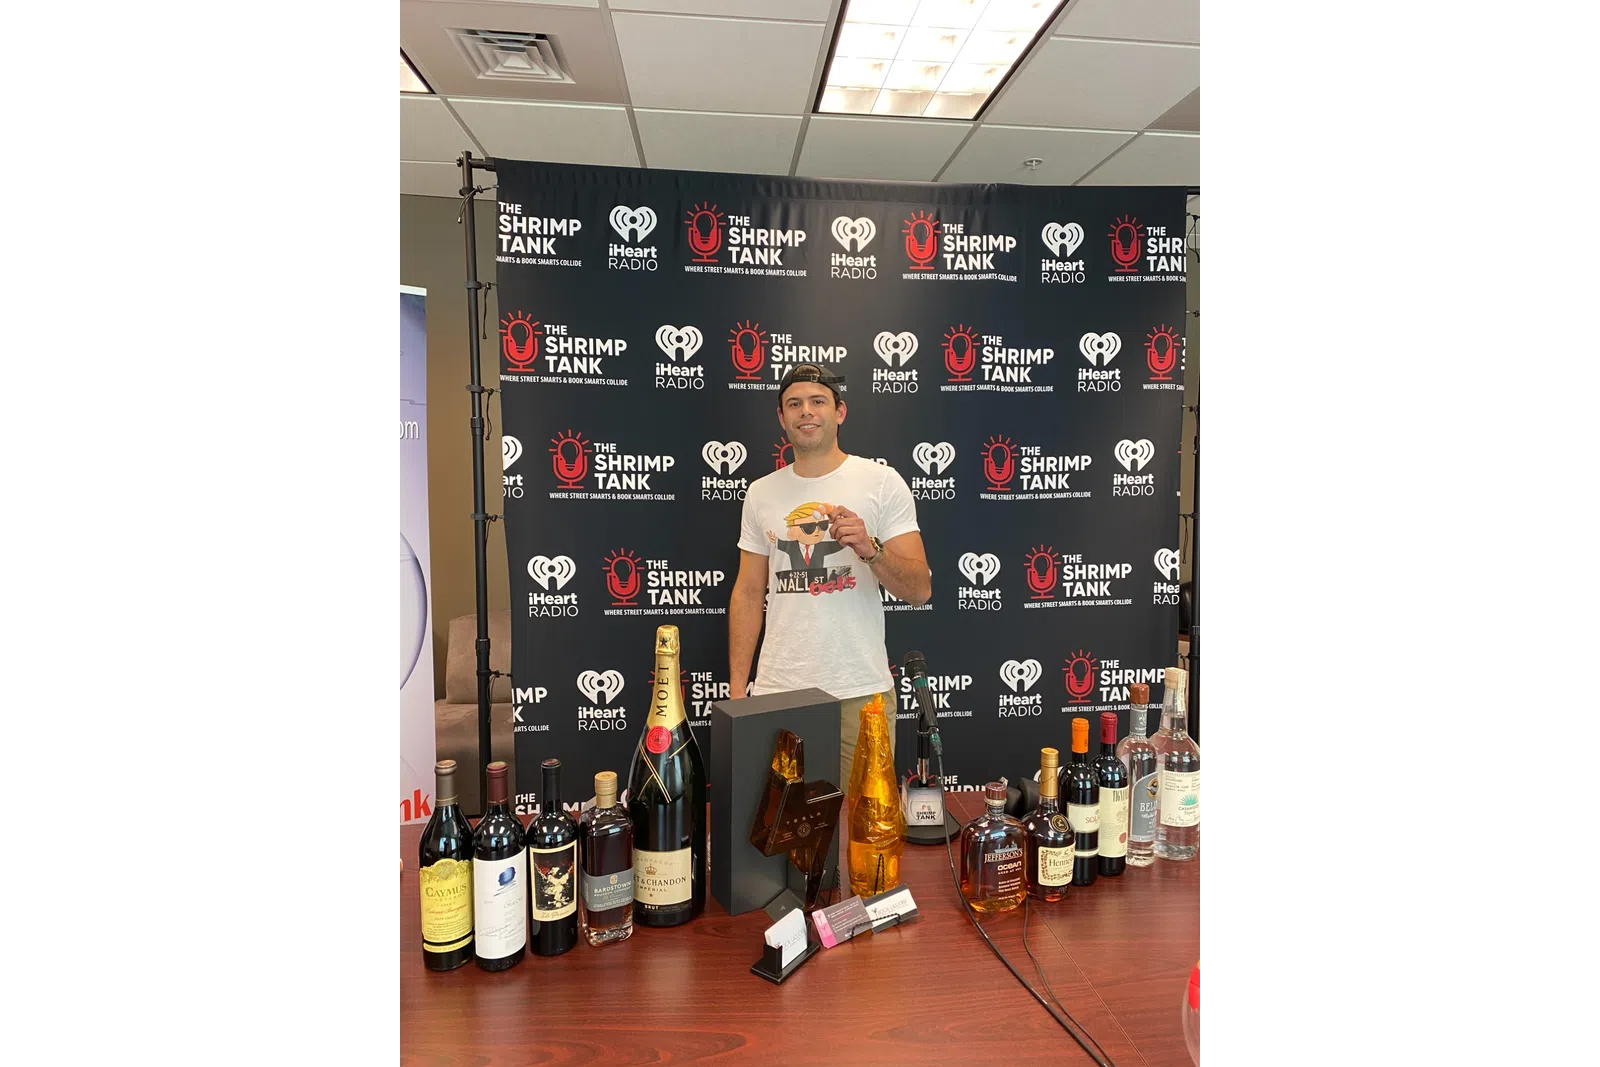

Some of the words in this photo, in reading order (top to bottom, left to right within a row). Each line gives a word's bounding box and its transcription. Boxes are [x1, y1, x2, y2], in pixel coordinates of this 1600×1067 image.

[498, 202, 522, 214] THE
[499, 214, 581, 236] SHRIMP
[728, 216, 750, 226] THE
[943, 224, 964, 234] THE
[1146, 227, 1166, 236] THE
[729, 227, 806, 247] SHRIMP
[498, 234, 556, 255] TANK
[943, 235, 1016, 252] SHRIMP
[609, 243, 657, 258] iHeart
[728, 246, 783, 265] TANK
[609, 258, 657, 271] RADIO
[831, 253, 876, 267] iHeart
[943, 253, 995, 270] TANK
[1042, 259, 1084, 271] iHeart
[831, 267, 877, 279] RADIO
[998, 274, 1017, 282] COLLIDE
[1042, 272, 1085, 283] RADIO
[544, 325, 567, 335] THE
[770, 334, 792, 344] THE
[982, 336, 1002, 346] THE
[546, 336, 627, 356] SHRIMP
[771, 345, 847, 363] SHRIMP
[982, 347, 1054, 364] SHRIMP
[545, 356, 602, 374] TANK
[656, 362, 703, 377] iHeart
[873, 368, 918, 381] iHeart
[981, 365, 1031, 382] TANK
[1078, 368, 1120, 380] iHeart
[656, 377, 704, 389] RADIO
[873, 382, 918, 393] RADIO
[1078, 380, 1121, 392] RADIO
[594, 443, 616, 453] THE
[1020, 446, 1040, 456] THE
[595, 454, 674, 472] SHRIMP
[1020, 455, 1092, 473] SHRIMP
[594, 473, 650, 490] TANK
[702, 476, 747, 488] iHeart
[912, 477, 955, 488] iHeart
[1020, 474, 1070, 490] TANK
[1114, 474, 1154, 485] iHeart
[702, 490, 747, 502] RADIO
[912, 489, 955, 501] RADIO
[1113, 485, 1154, 496] RADIO
[646, 560, 668, 569] THE
[1062, 554, 1082, 564] THE
[1063, 563, 1132, 580] SHRIMP
[648, 571, 724, 587] SHRIMP
[959, 587, 1001, 599] iHeart
[1062, 581, 1111, 597] TANK
[1154, 582, 1180, 593] iHea
[529, 592, 577, 605] iHeart
[647, 589, 702, 605] TANK
[1154, 594, 1179, 604] RAD
[959, 599, 1002, 610] RADIO
[529, 606, 578, 617] RADIO
[1100, 660, 1119, 669] THE
[691, 672, 712, 681] THE
[1100, 669, 1166, 685] SHRIMP
[901, 675, 972, 692] SRIMP
[999, 694, 1042, 706] iHeart
[1100, 686, 1132, 702] TAN
[578, 706, 626, 718] iHeart
[999, 705, 1042, 717] RADIO
[578, 719, 626, 730] RADIO
[938, 775, 958, 784] THE
[516, 793, 535, 804] THE
[634, 858, 673, 866] HAMPAGNE
[1049, 858, 1073, 866] Hennes
[594, 881, 631, 893] BARDSTOWN
[646, 876, 686, 886] CHANDON
[426, 885, 466, 897] CAYMUS
